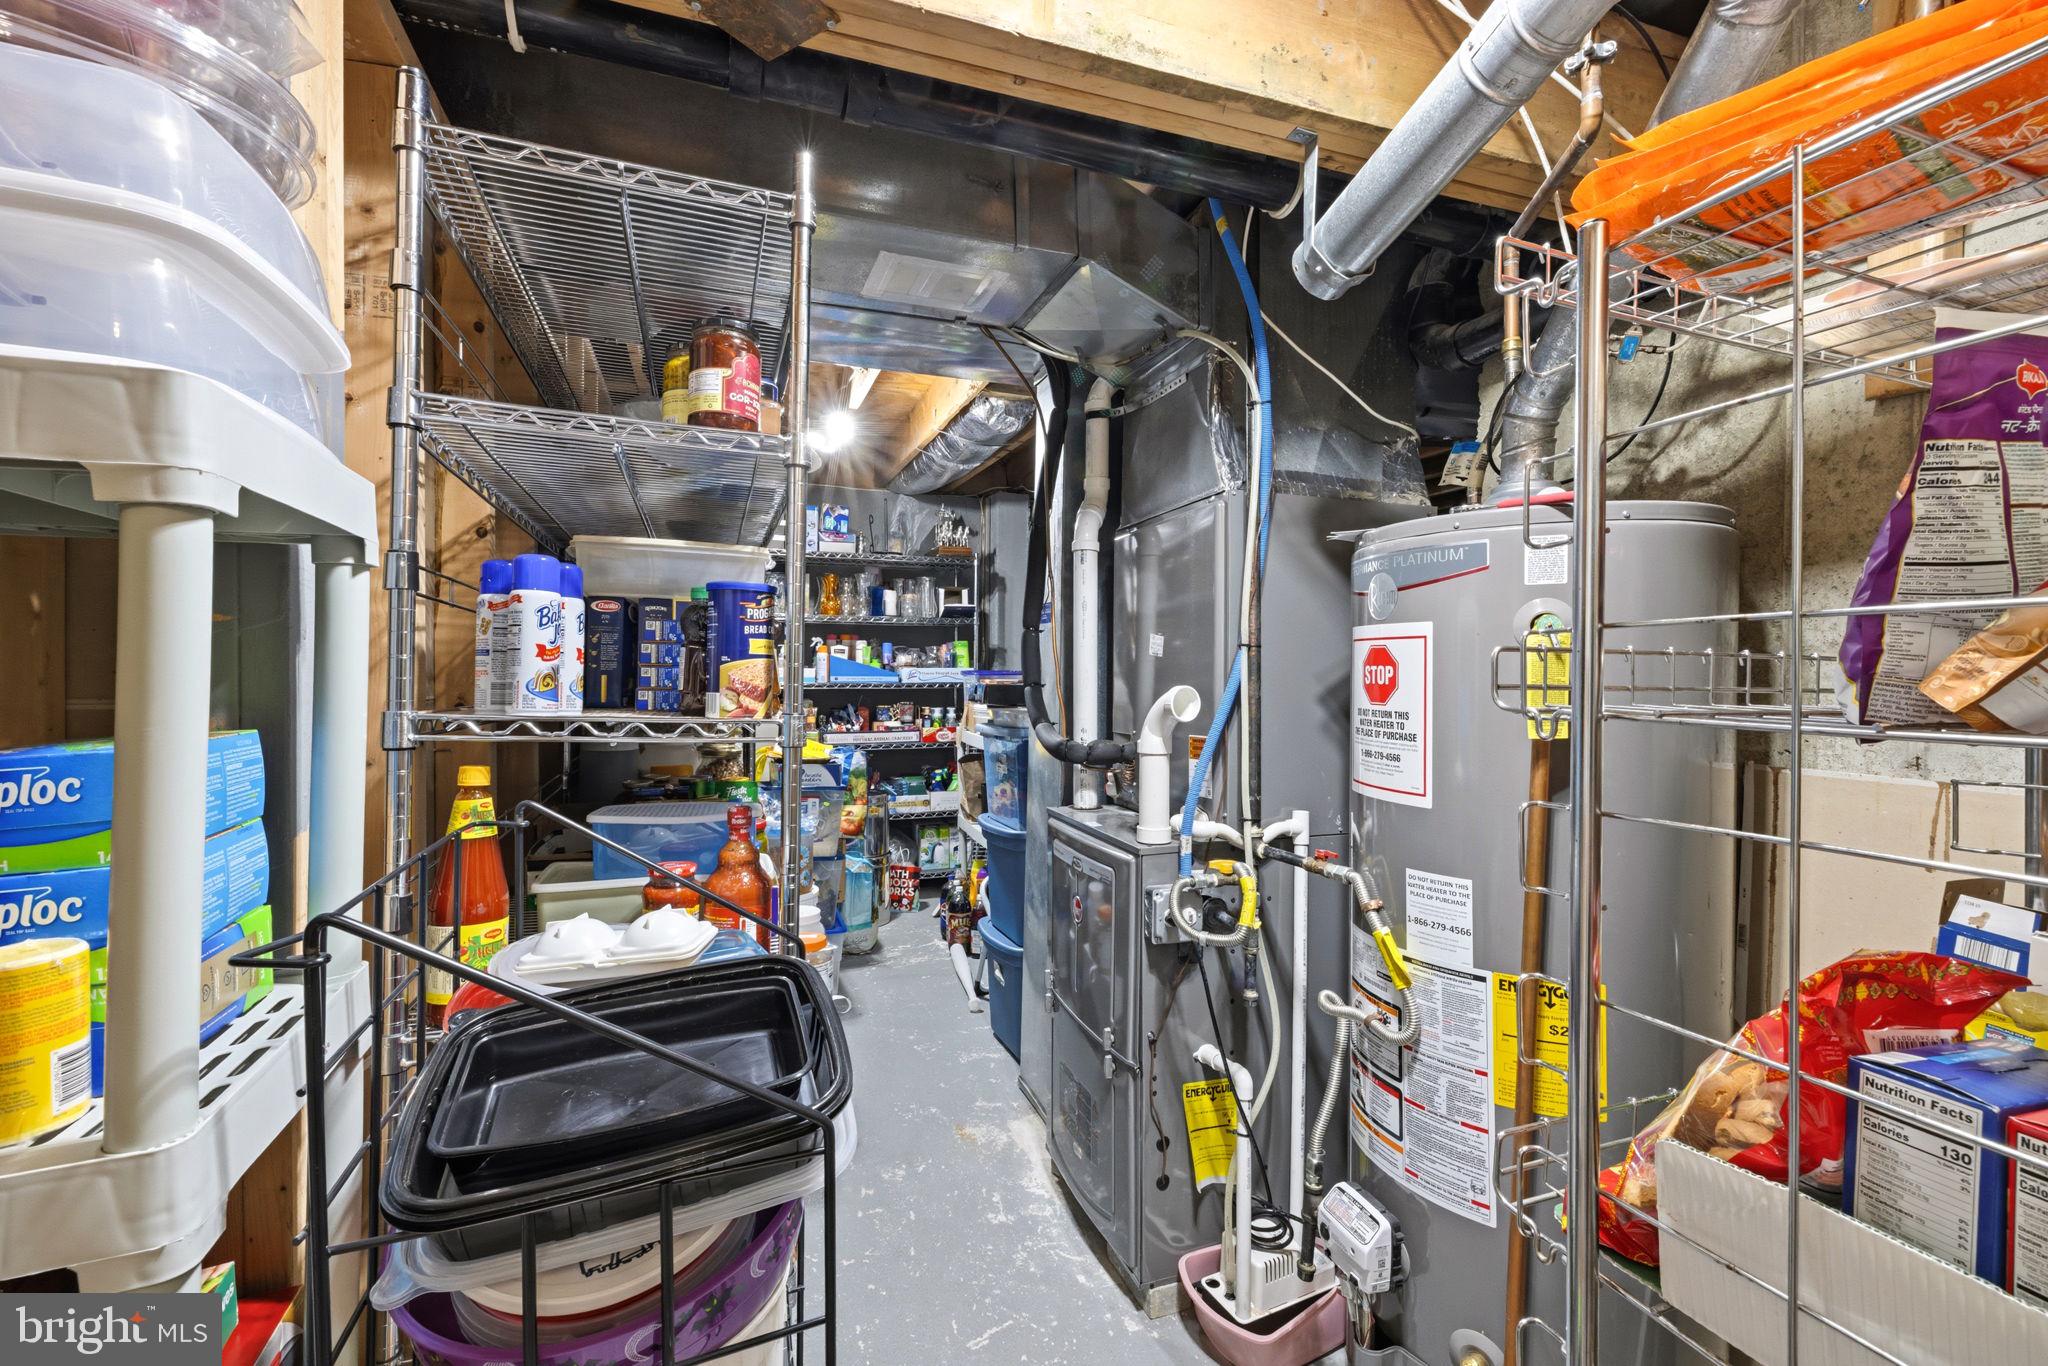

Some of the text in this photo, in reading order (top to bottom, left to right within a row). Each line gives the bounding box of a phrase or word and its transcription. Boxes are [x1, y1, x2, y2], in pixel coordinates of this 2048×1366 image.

[1393, 547, 1464, 569] PLATINUM
[1364, 665, 1394, 685] STOP
[1371, 710, 1393, 719] RETURN
[1394, 711, 1410, 720] THIS
[1373, 720, 1394, 730] HEATER
[1396, 722, 1405, 731] TO
[1360, 727, 1374, 738] PLACE
[1375, 729, 1382, 739] OF
[1382, 731, 1418, 743] PURCHASE
[1407, 882, 1425, 890] WATER
[1425, 885, 1447, 895] HEATER
[1458, 891, 1471, 900] THE
[1408, 873, 1469, 891] DO NOT RETURN THIS
[1409, 890, 1426, 899] PLACE
[1435, 896, 1468, 907] PURCHASE
[1407, 915, 1472, 937] 1-866-279-4566
[1865, 1076, 1926, 1107] Nutrition
[1930, 1100, 1973, 1124] Facts
[1863, 1117, 1972, 1166] Calories 130
